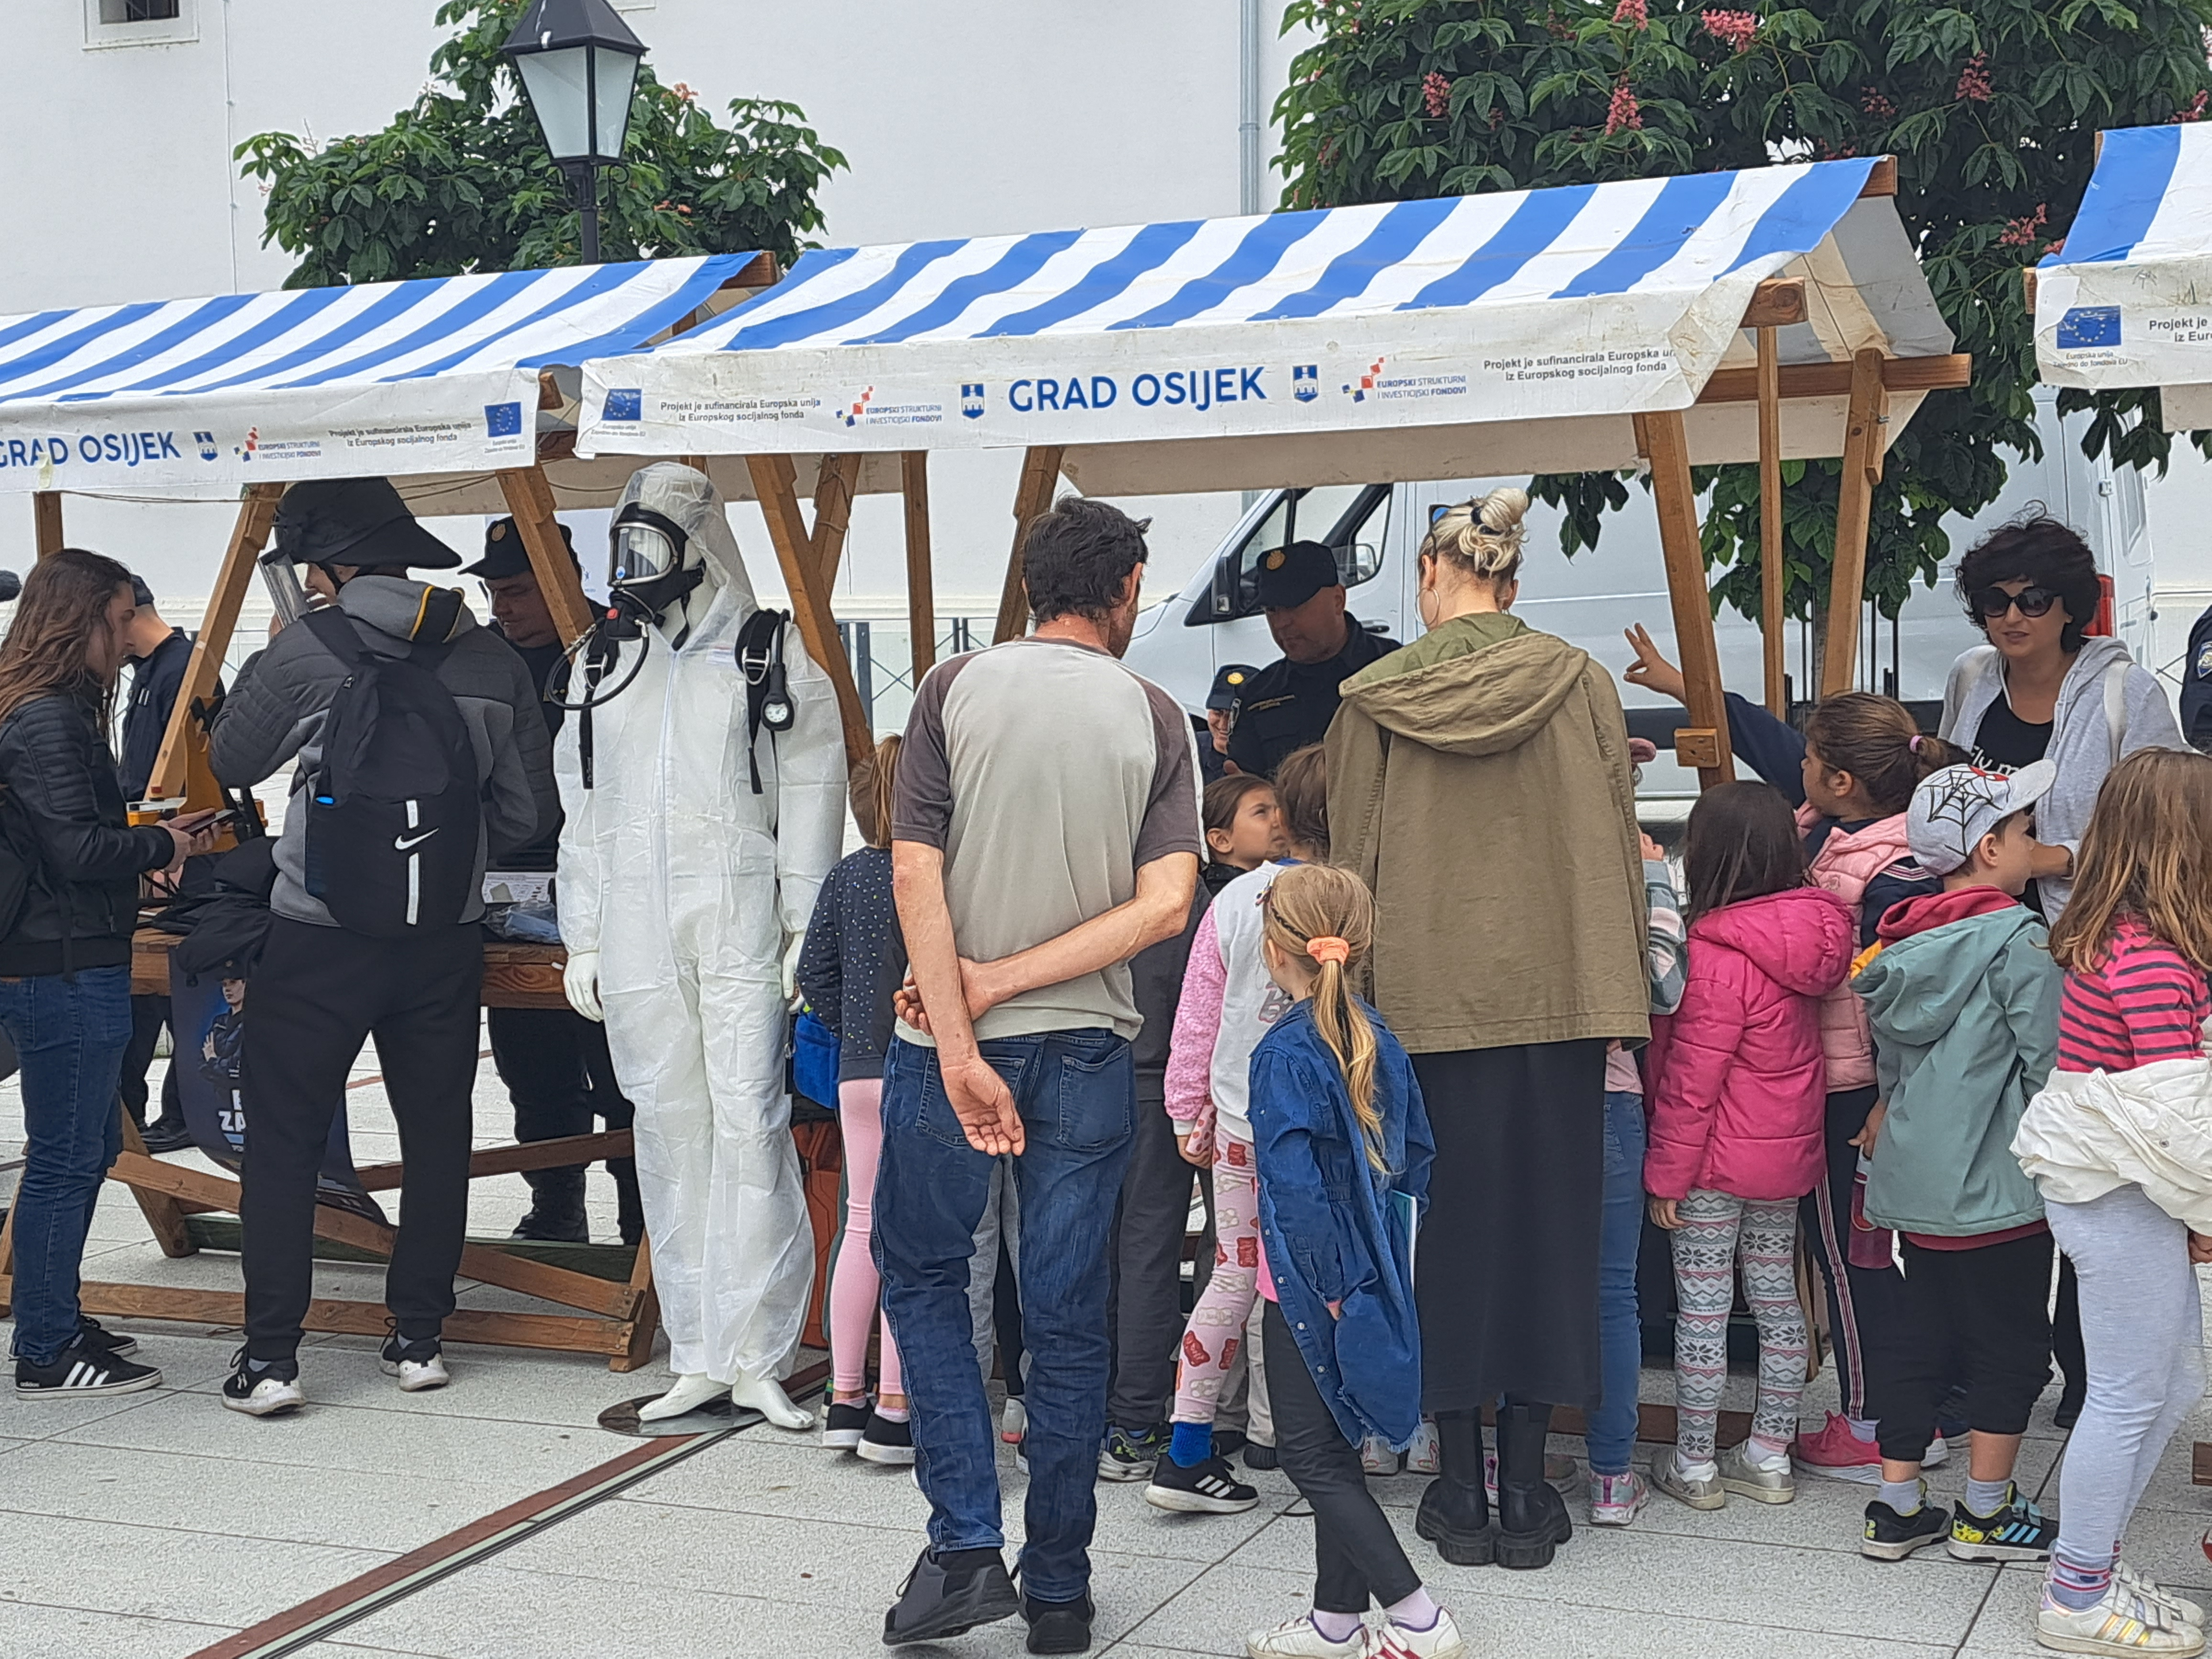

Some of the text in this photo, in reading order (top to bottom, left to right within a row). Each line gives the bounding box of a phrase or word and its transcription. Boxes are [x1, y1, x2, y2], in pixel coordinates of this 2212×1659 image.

[2149, 317, 2208, 331] Projekt je
[2175, 331, 2212, 342] iz Eur
[1484, 360, 1521, 371] Projekt
[1524, 358, 1533, 369] je
[1537, 353, 1605, 366] sufinancirala
[1608, 349, 1659, 361] Europska
[1505, 362, 1667, 381] iz Europskog socijalnog fonda
[1377, 376, 1466, 388] EUROPSKI STRUKTURNI
[1008, 366, 1267, 412] GRAD OSIJEK
[1431, 387, 1466, 396] FONDOVI
[661, 398, 821, 411] Projekt je sufinancirala Europska unija
[688, 412, 734, 423] Europskog
[736, 412, 779, 422] socijalnog
[781, 410, 805, 420] fonda
[414, 423, 451, 433] Europska
[355, 437, 395, 447] Europskog
[437, 432, 457, 441] fonda
[79, 431, 182, 467] OSIJEK
